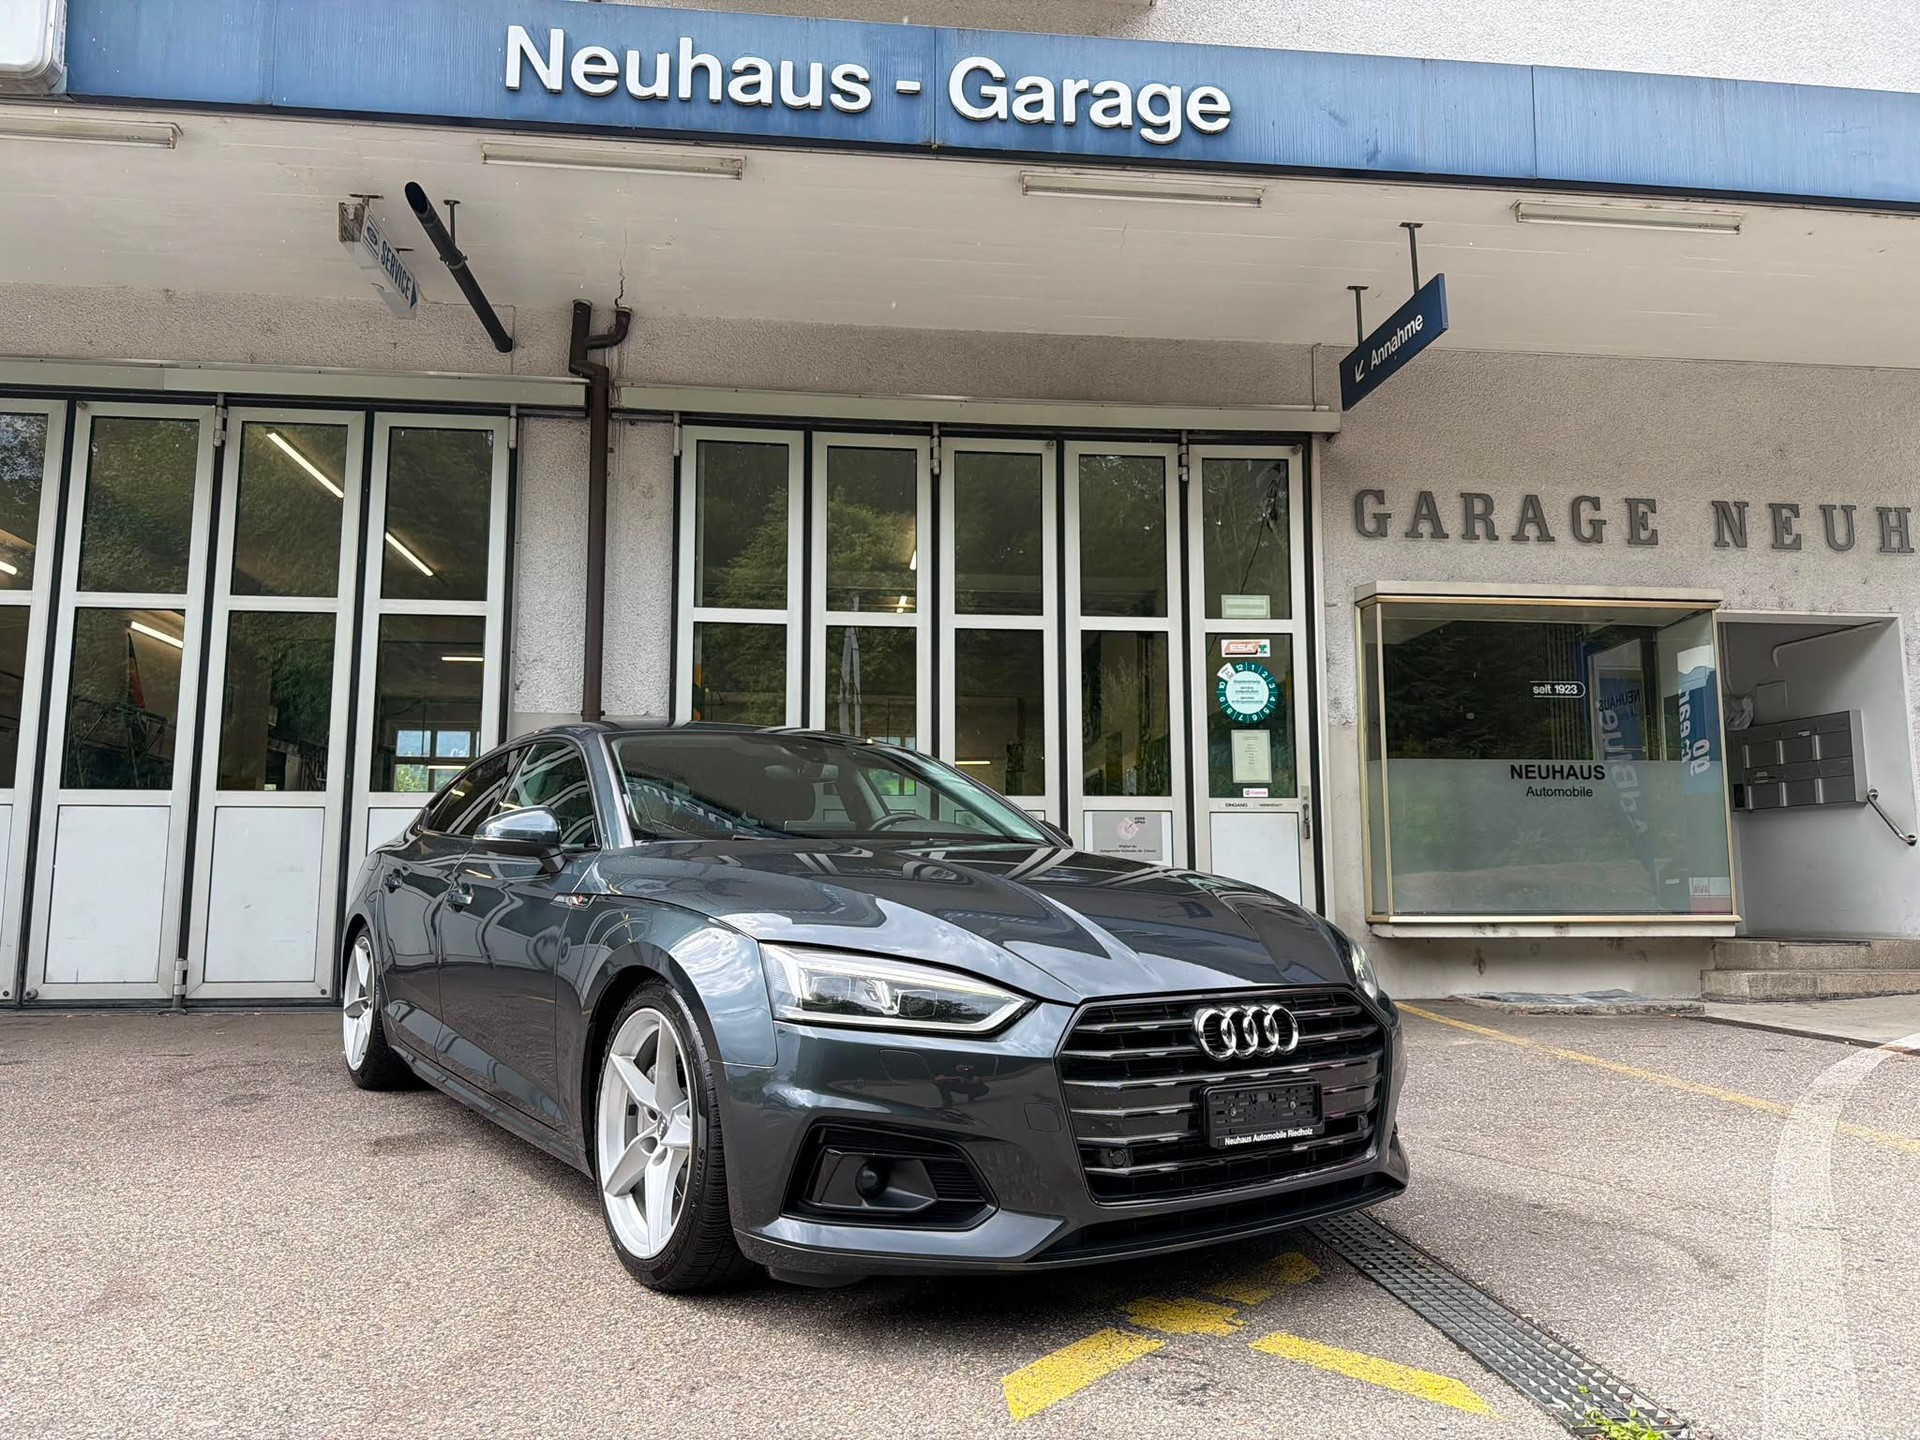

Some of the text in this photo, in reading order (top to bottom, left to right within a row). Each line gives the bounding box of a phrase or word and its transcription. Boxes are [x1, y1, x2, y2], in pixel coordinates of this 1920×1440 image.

[505, 25, 872, 113] Neuhaus
[949, 56, 1231, 145] Garage
[381, 240, 411, 301] SERVICE
[1370, 314, 1424, 370] Annahme
[1355, 489, 1915, 555] GARAGE NEUH
[1532, 684, 1578, 695] seit 1923
[1510, 764, 1606, 781] NEUHAUS
[1526, 786, 1594, 798] Automobile
[1224, 1128, 1313, 1146] Neuhaus Automobile Riedholz
